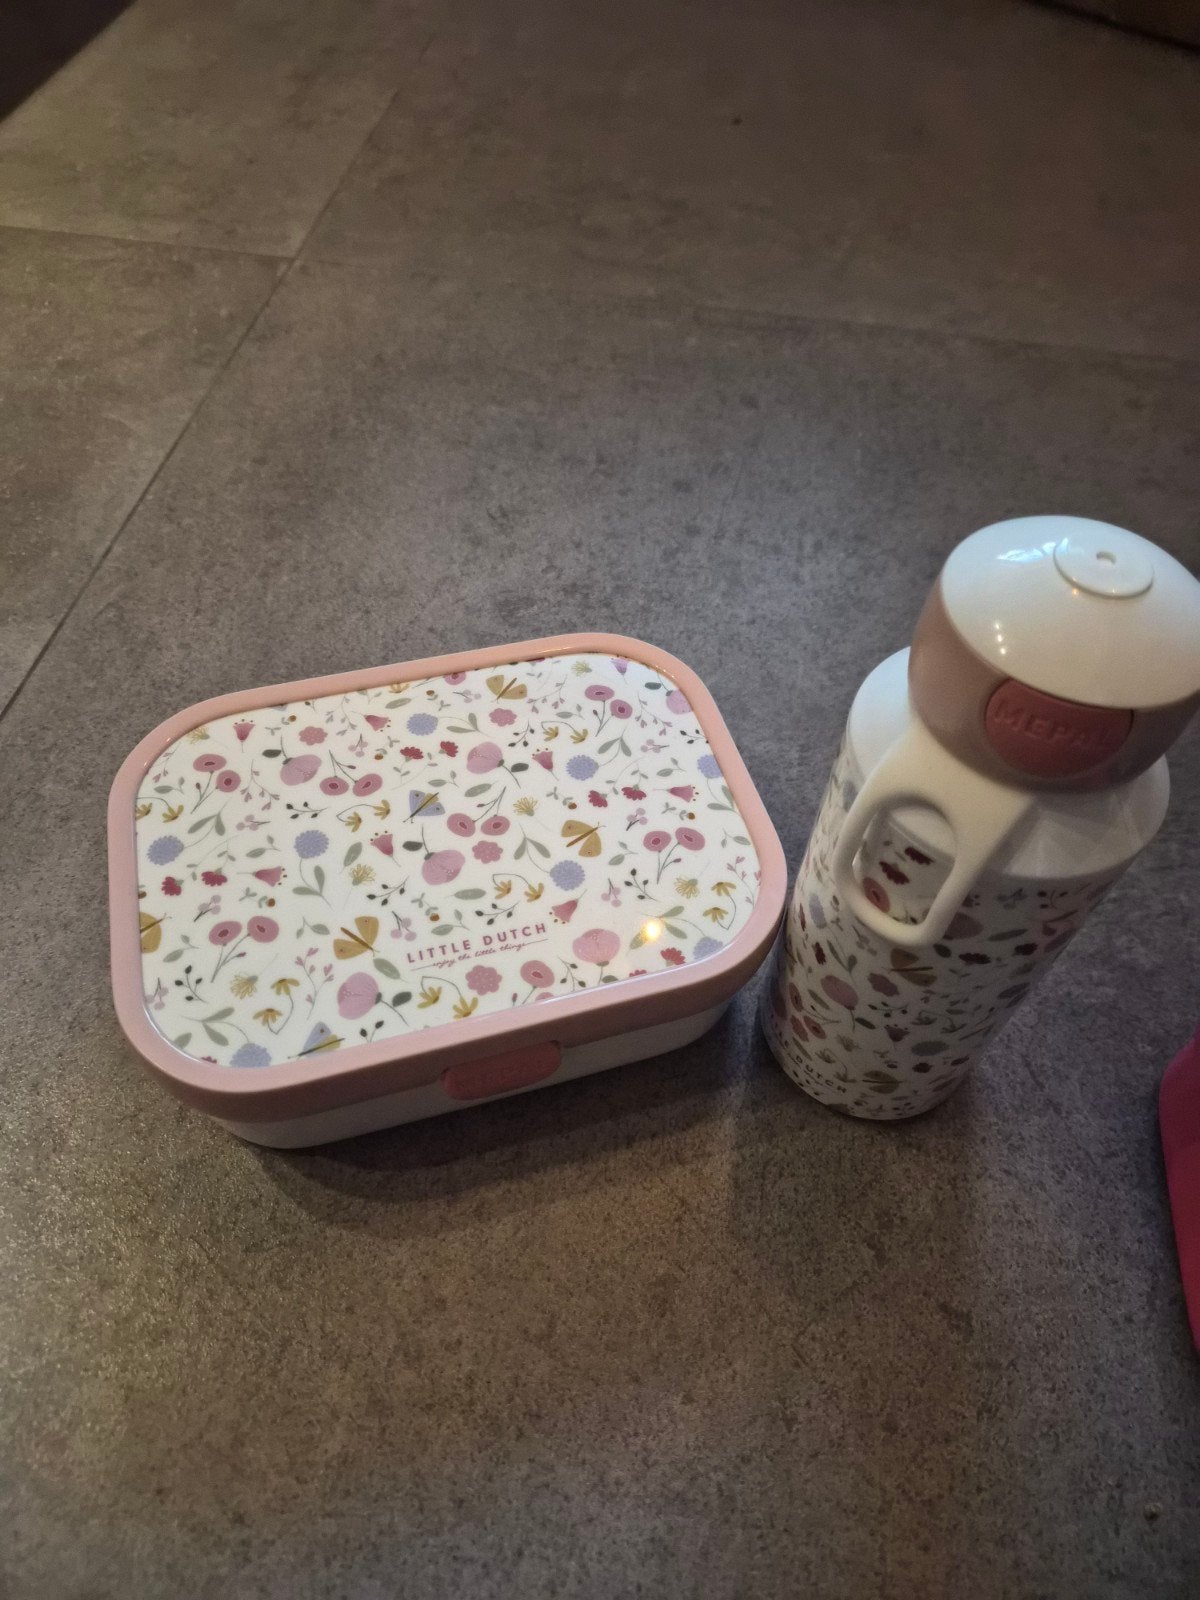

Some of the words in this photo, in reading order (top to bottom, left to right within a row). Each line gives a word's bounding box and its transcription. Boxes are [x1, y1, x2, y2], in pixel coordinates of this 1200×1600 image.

[406, 939, 472, 964] LITTLE
[482, 923, 547, 947] DUTCH
[457, 953, 471, 961] the
[474, 947, 497, 957] little
[796, 1055, 847, 1094] DUTCH
